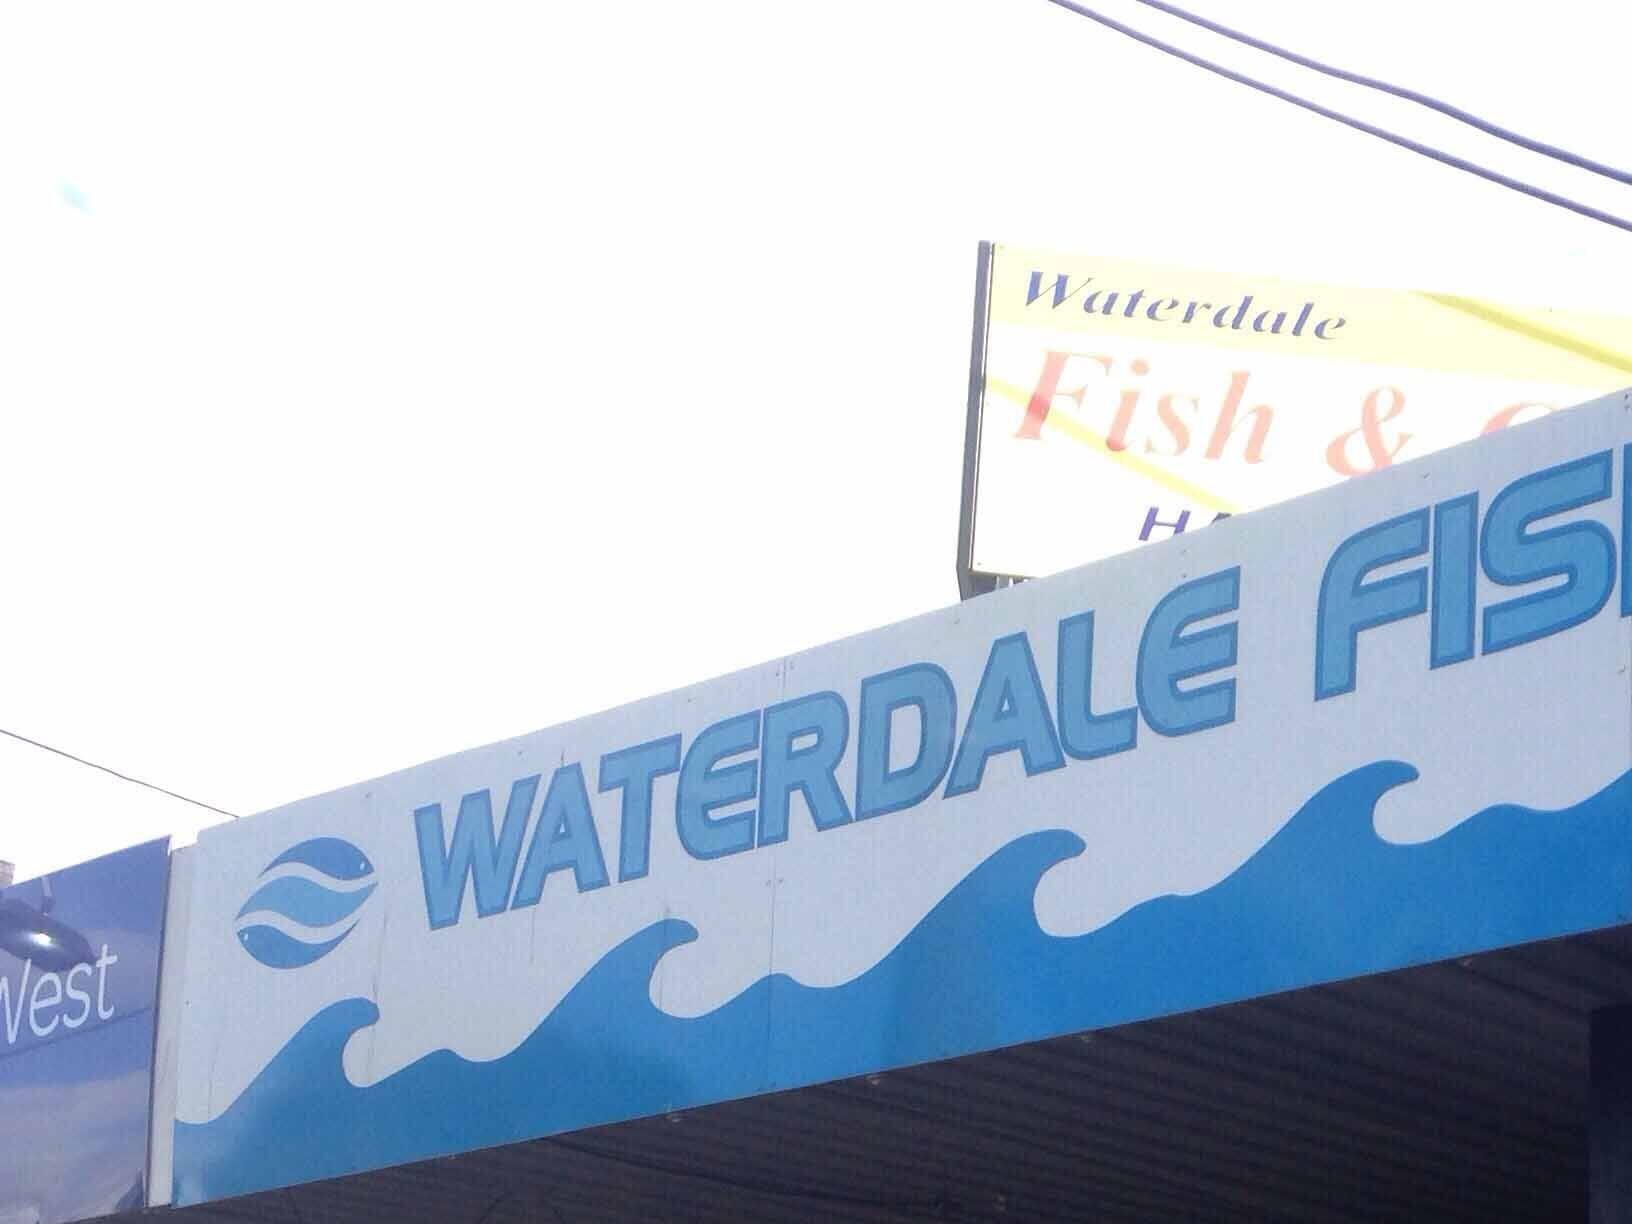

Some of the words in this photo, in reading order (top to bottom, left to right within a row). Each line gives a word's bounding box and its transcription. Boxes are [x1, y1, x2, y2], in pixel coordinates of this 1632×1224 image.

[1023, 270, 1347, 341] Waterdale
[1012, 347, 1275, 466] Fish
[1325, 385, 1415, 478] &
[414, 565, 1242, 931] WATERDALE
